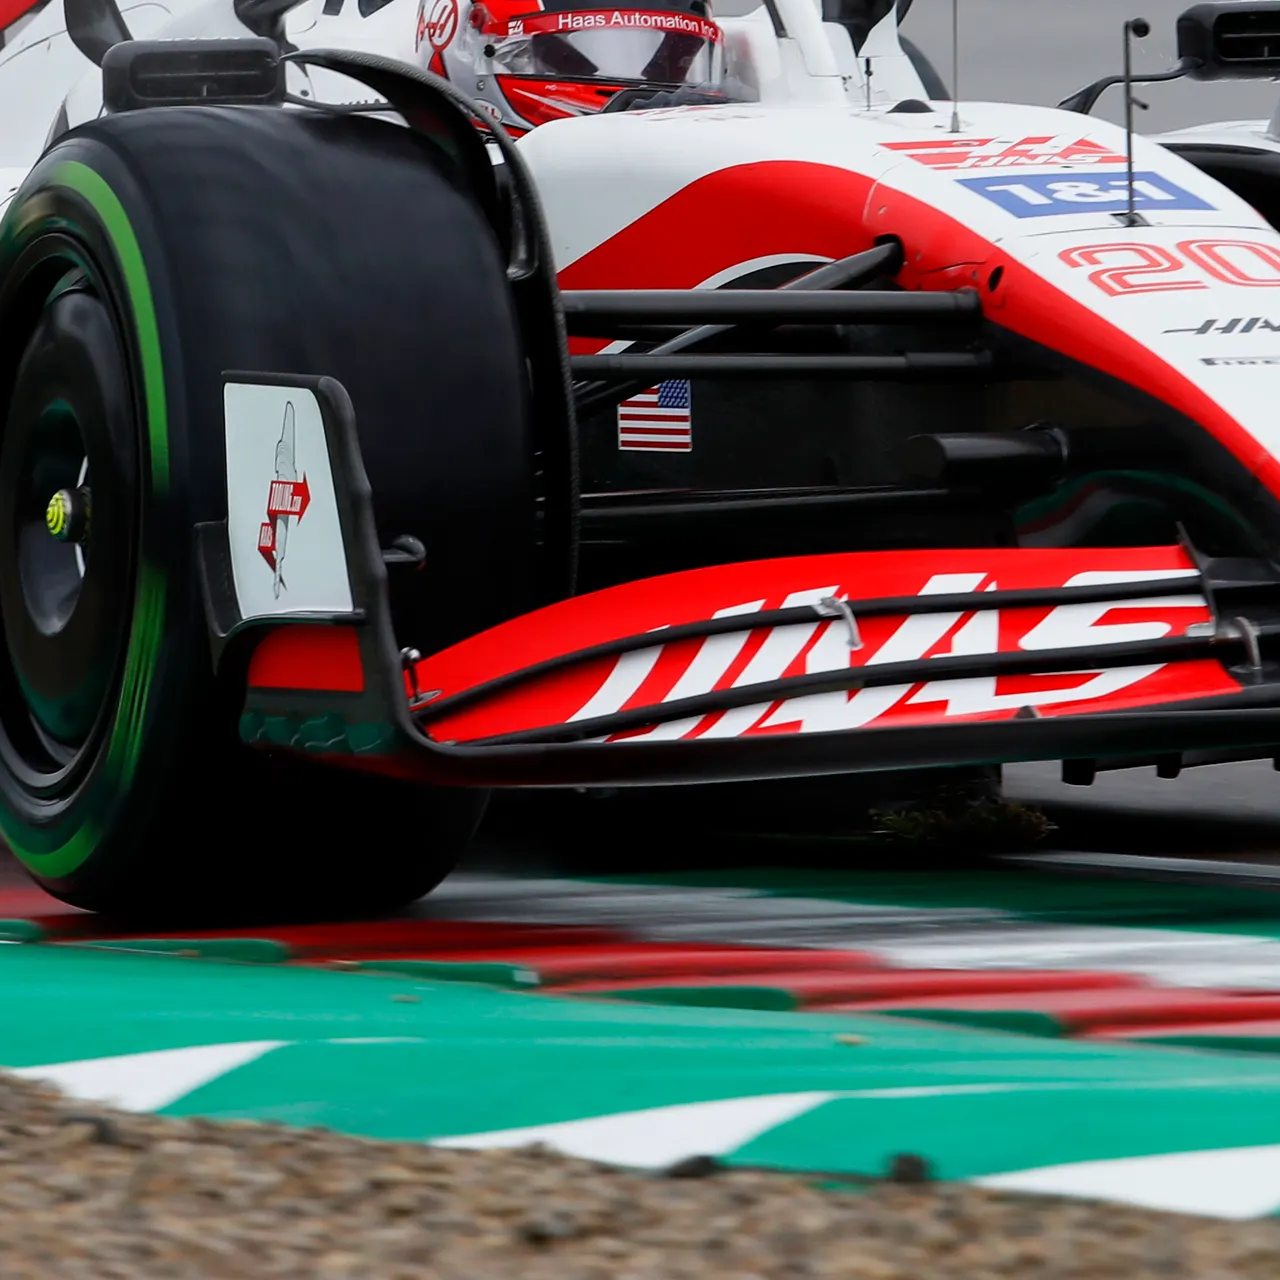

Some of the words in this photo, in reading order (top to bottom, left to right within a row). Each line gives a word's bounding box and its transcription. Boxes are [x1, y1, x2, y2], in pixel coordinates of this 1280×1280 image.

[558, 12, 606, 30] Haas
[610, 10, 700, 34] Automation
[700, 23, 717, 40] Inc.
[985, 179, 1177, 207] 1&1
